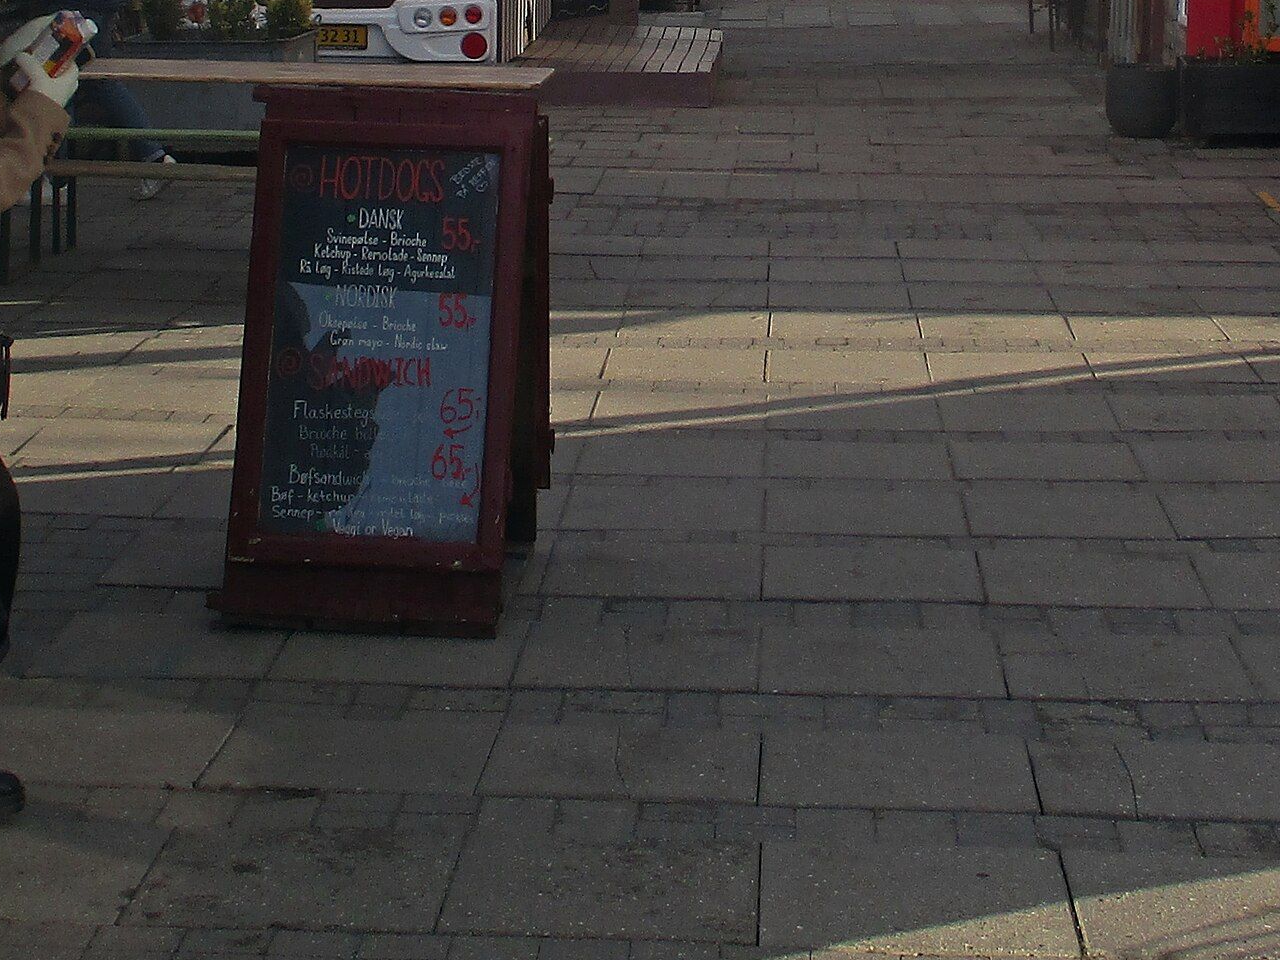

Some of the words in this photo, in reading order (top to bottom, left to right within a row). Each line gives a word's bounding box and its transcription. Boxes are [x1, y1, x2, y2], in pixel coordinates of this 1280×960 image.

[320, 28, 338, 43] 32
[342, 28, 358, 43] 31
[358, 208, 404, 230] DANSK
[326, 227, 380, 248] Svinepølse
[389, 231, 427, 248] Brioche
[313, 243, 352, 263] Ketchup
[416, 248, 449, 267] Sennep
[299, 259, 312, 274] Rå
[334, 283, 398, 309] NORDISK
[382, 315, 417, 332] Brioche
[329, 330, 355, 348] Grøn
[270, 485, 295, 507] Bøf
[381, 518, 415, 540] Vegan
